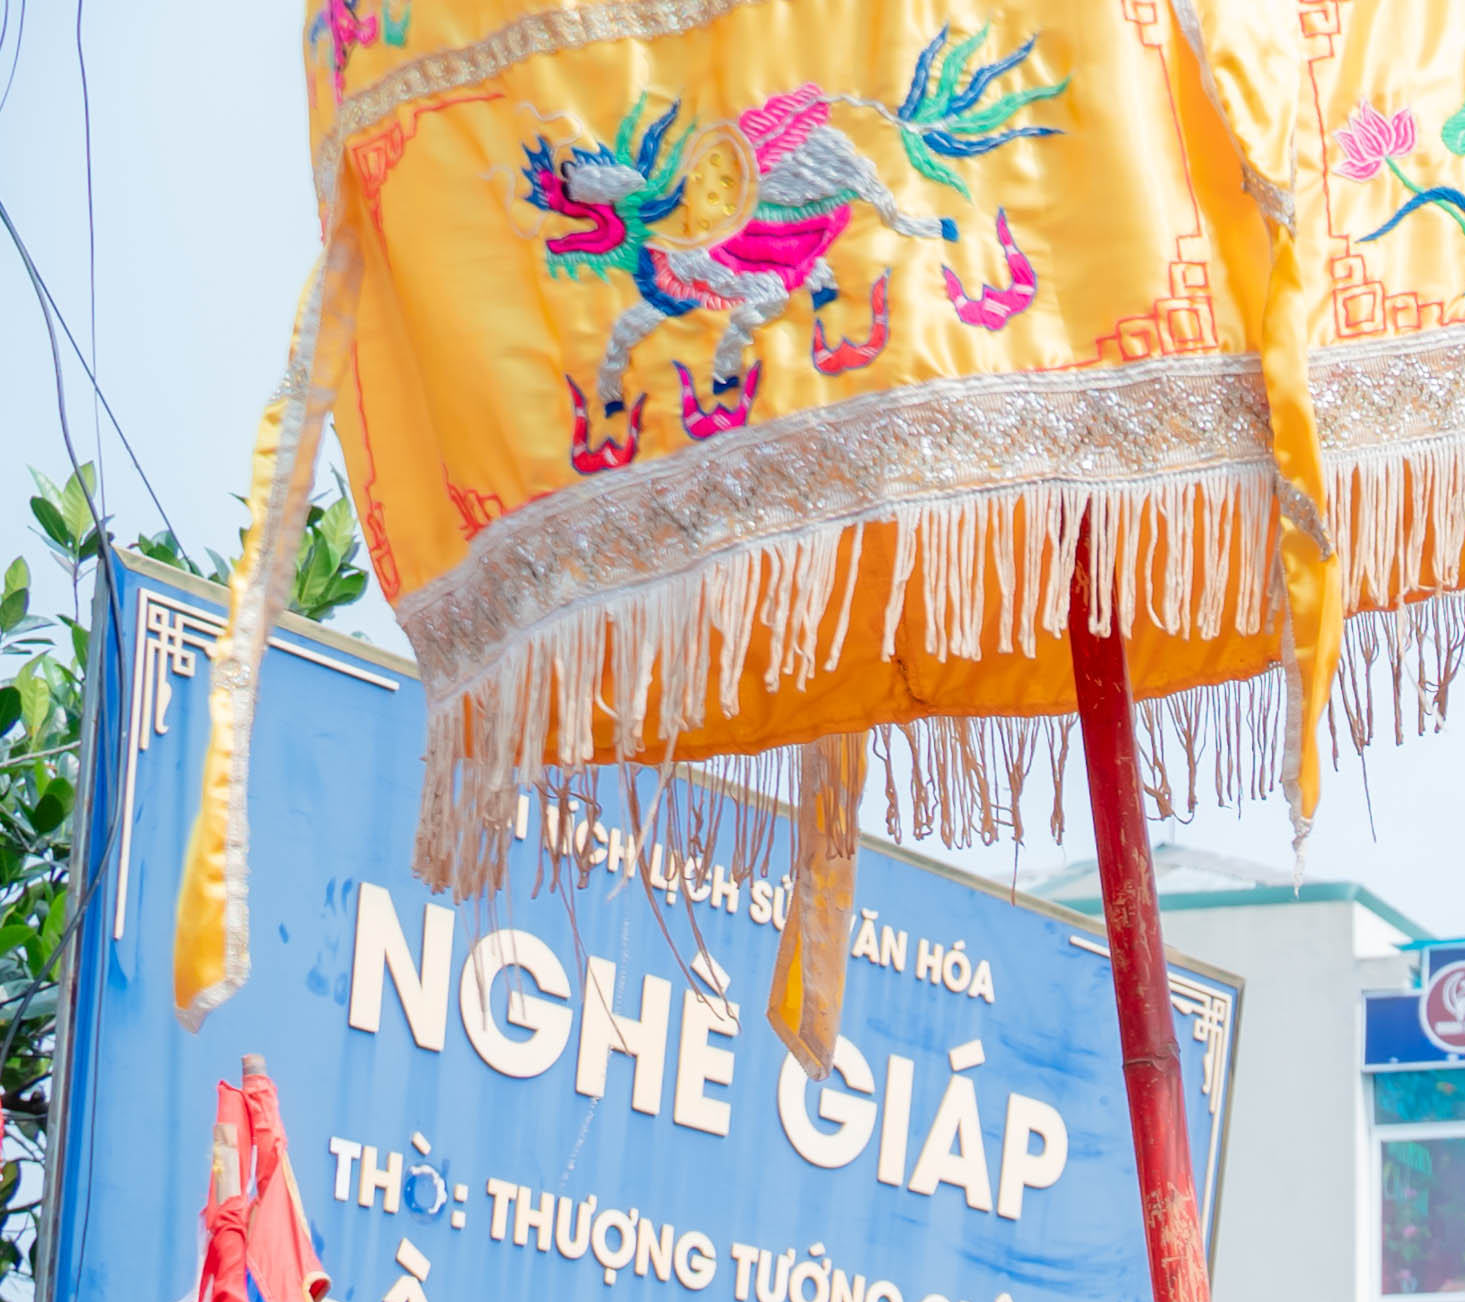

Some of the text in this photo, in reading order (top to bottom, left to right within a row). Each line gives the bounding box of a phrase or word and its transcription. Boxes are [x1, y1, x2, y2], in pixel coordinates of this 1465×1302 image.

[649, 842, 740, 914] LỊCH
[849, 908, 908, 972] ĂN
[916, 939, 996, 1004] HÓA
[349, 881, 1069, 1222] NGHÈ GIÁP
[487, 1177, 717, 1291] THƯỢNG
